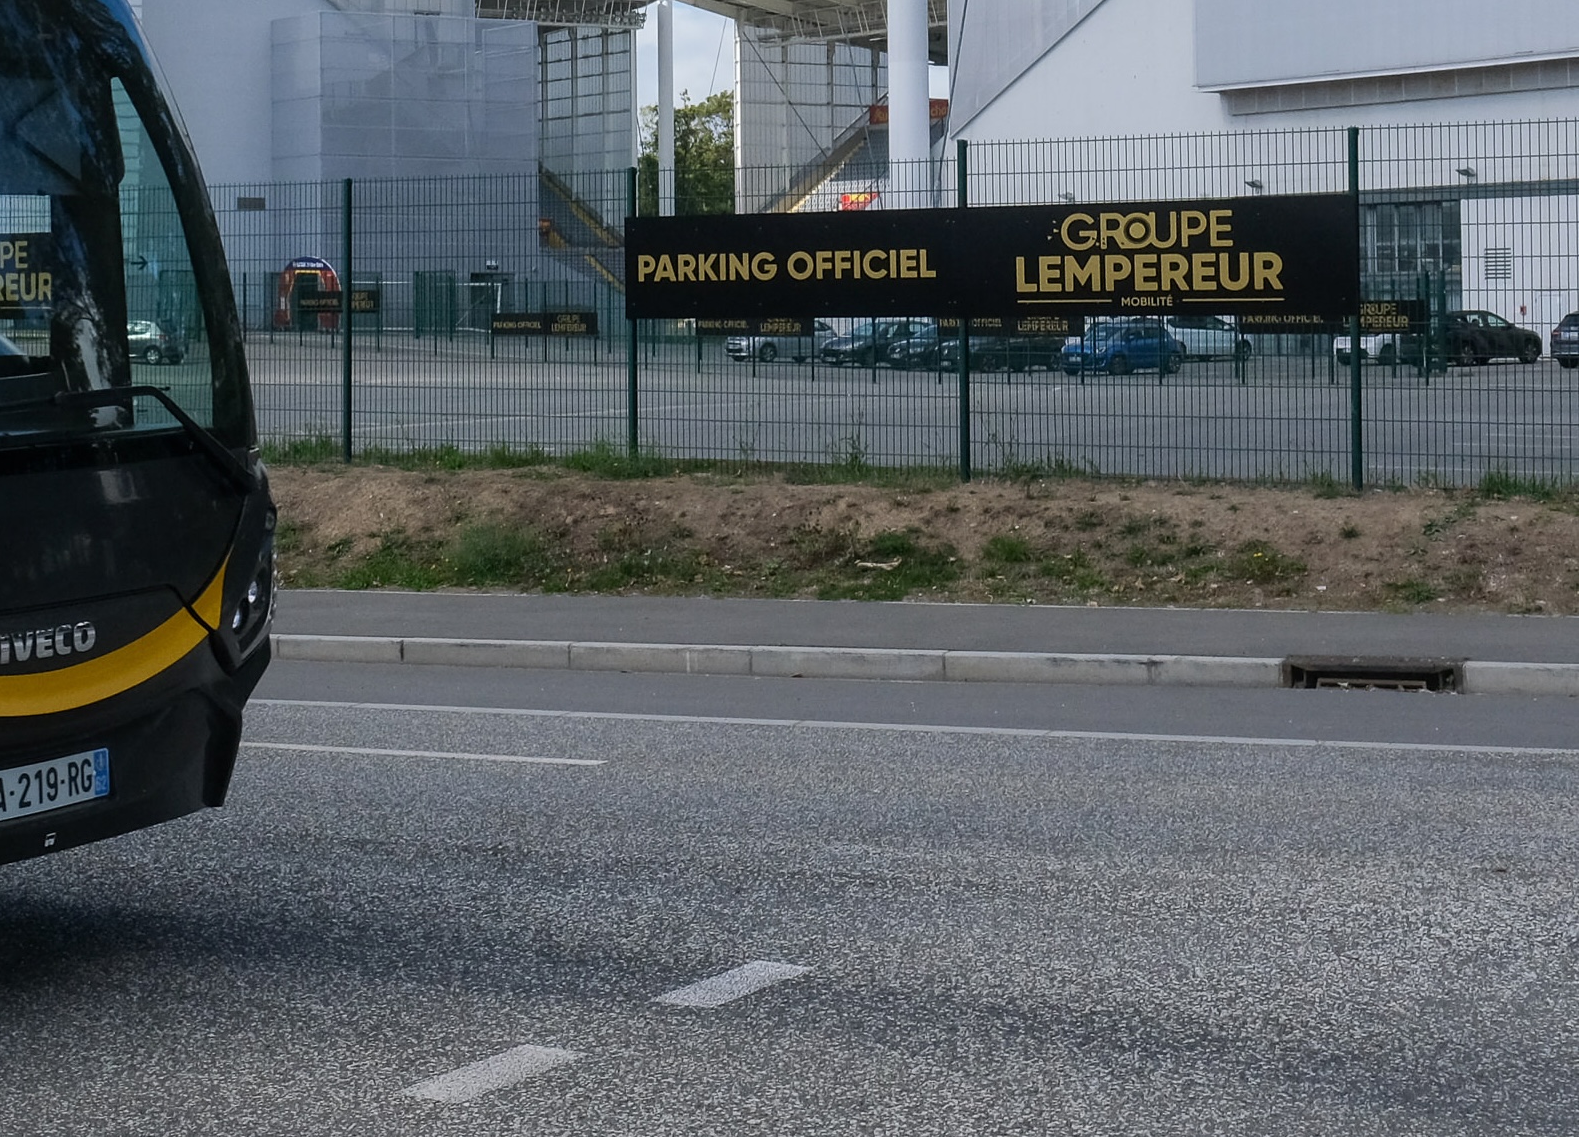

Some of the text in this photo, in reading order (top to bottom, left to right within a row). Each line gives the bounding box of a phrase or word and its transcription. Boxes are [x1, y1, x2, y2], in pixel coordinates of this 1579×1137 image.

[1060, 209, 1234, 251] GROUPE
[637, 248, 937, 283] PARKING OFFICIEL
[1015, 251, 1284, 293] LEMPEREUR
[1120, 294, 1174, 307] MOBILITÉ
